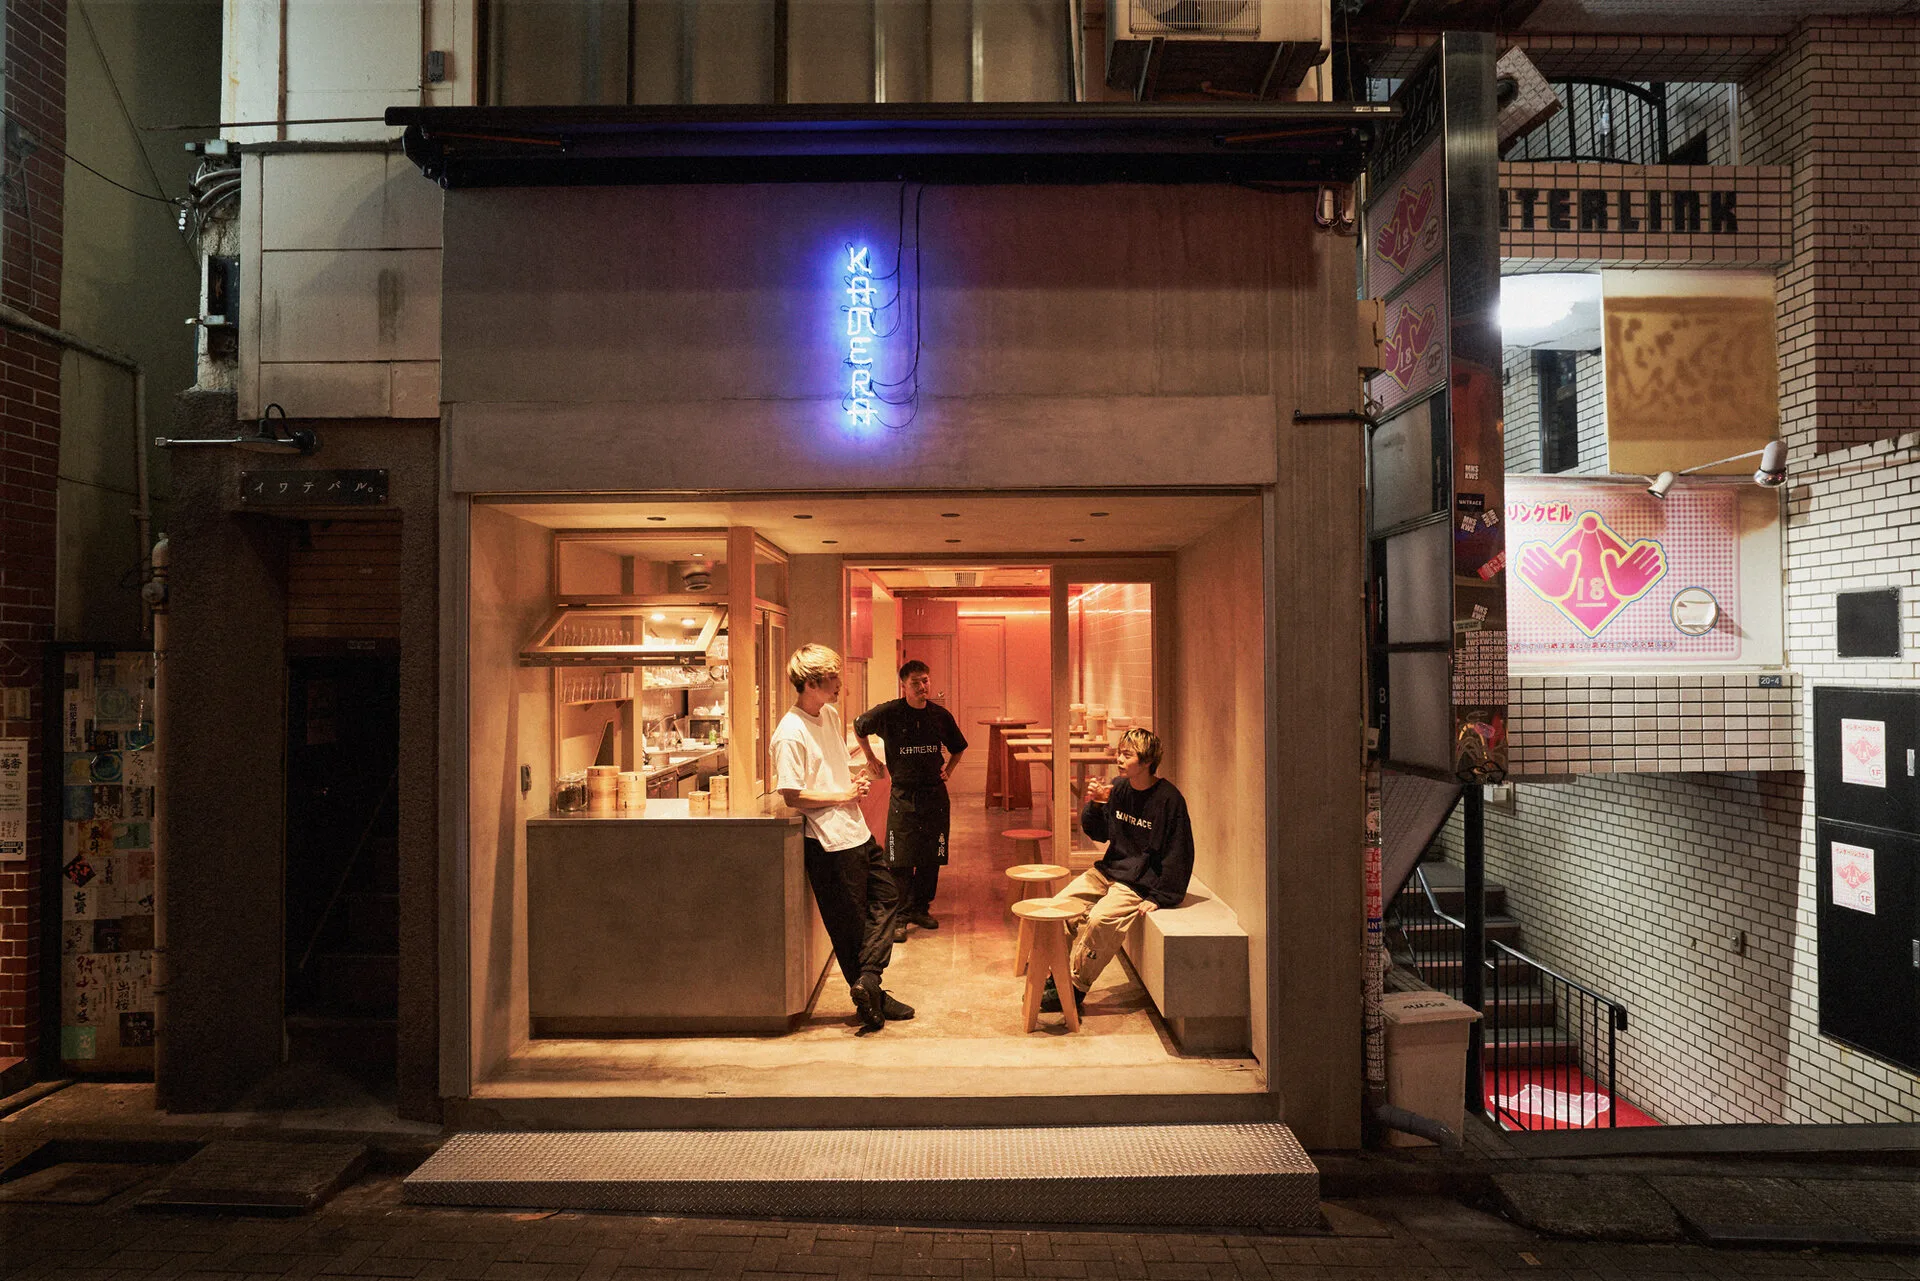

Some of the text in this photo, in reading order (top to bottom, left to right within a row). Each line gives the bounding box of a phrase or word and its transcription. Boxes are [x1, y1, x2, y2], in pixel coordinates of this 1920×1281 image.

[846, 246, 879, 427] KAMERA
[253, 481, 374, 494] イワテバル。
[1507, 503, 1573, 522] リンクビル
[1576, 577, 1606, 601] 18
[1760, 677, 1780, 685] 20-4
[899, 745, 938, 755] KAMERA
[1861, 895, 1872, 903] 1F
